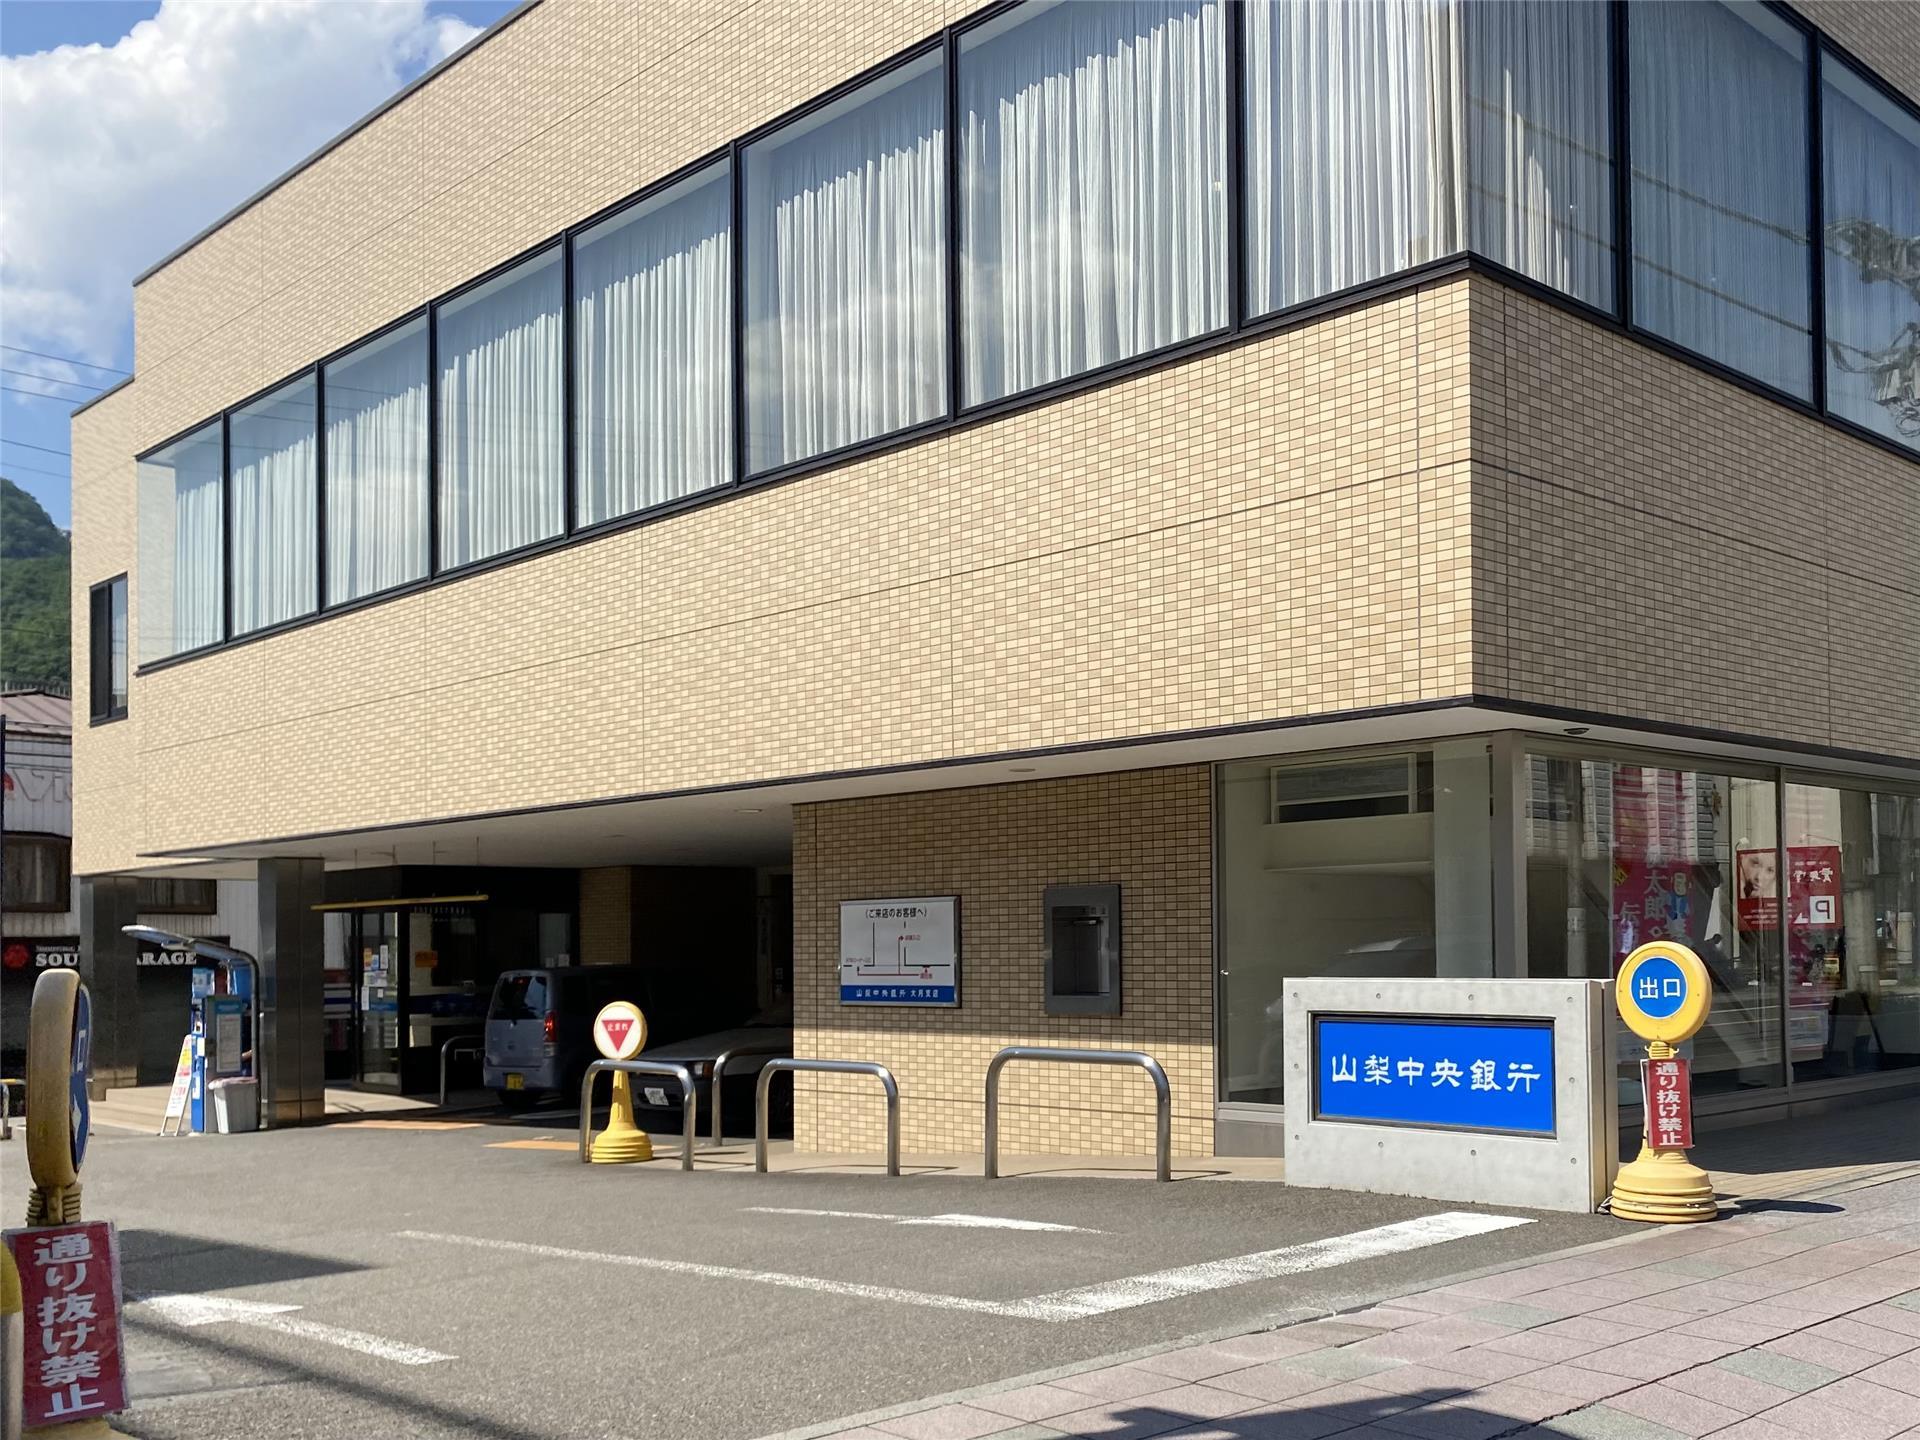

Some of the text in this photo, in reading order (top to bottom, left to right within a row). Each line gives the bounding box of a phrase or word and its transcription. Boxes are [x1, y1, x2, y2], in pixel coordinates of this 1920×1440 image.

[35, 953, 78, 967] SOU
[1639, 976, 1681, 1000] 出口
[1332, 1053, 1541, 1094] 山梨中央銀行
[1655, 1062, 1684, 1146] 通り抜け禁止
[34, 1233, 105, 1418] 通り抜け禁止
